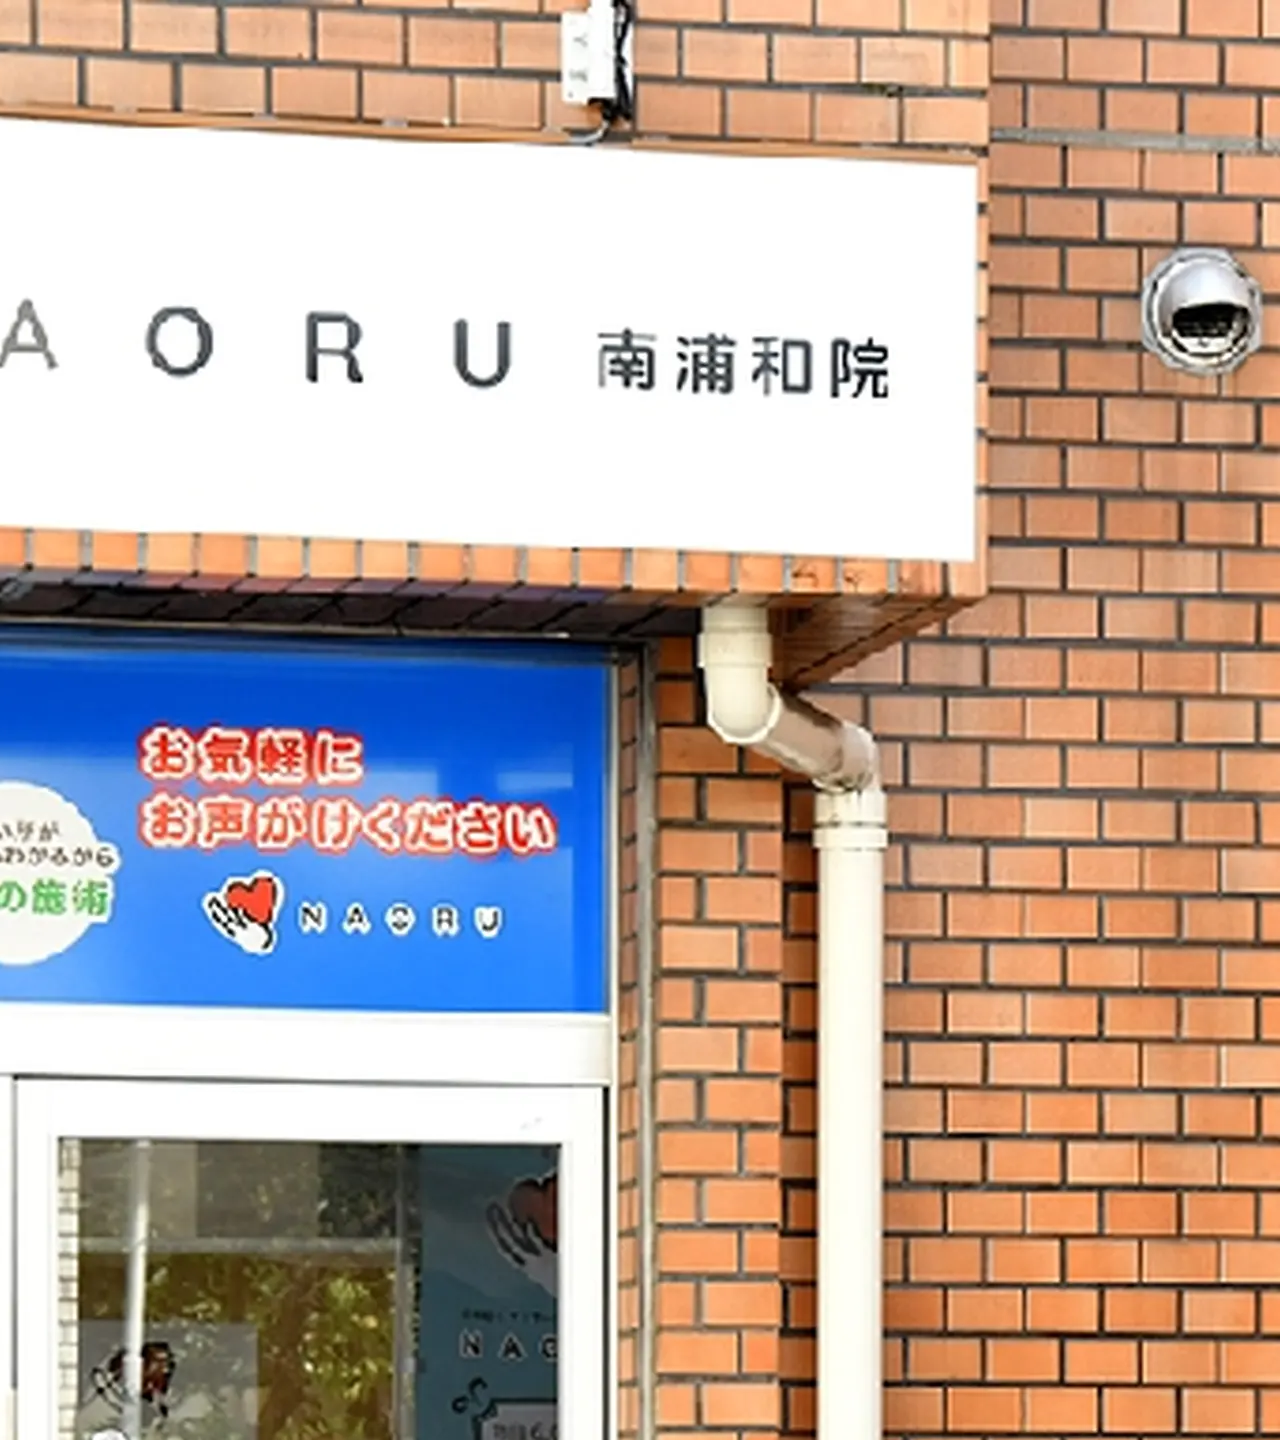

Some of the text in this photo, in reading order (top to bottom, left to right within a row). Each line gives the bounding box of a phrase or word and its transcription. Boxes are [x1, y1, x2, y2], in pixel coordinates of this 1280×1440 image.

[596, 327, 889, 398] 南浦和院
[143, 728, 362, 784] お気軽に
[142, 794, 555, 853] お声がけください
[301, 906, 500, 931] NAORU
